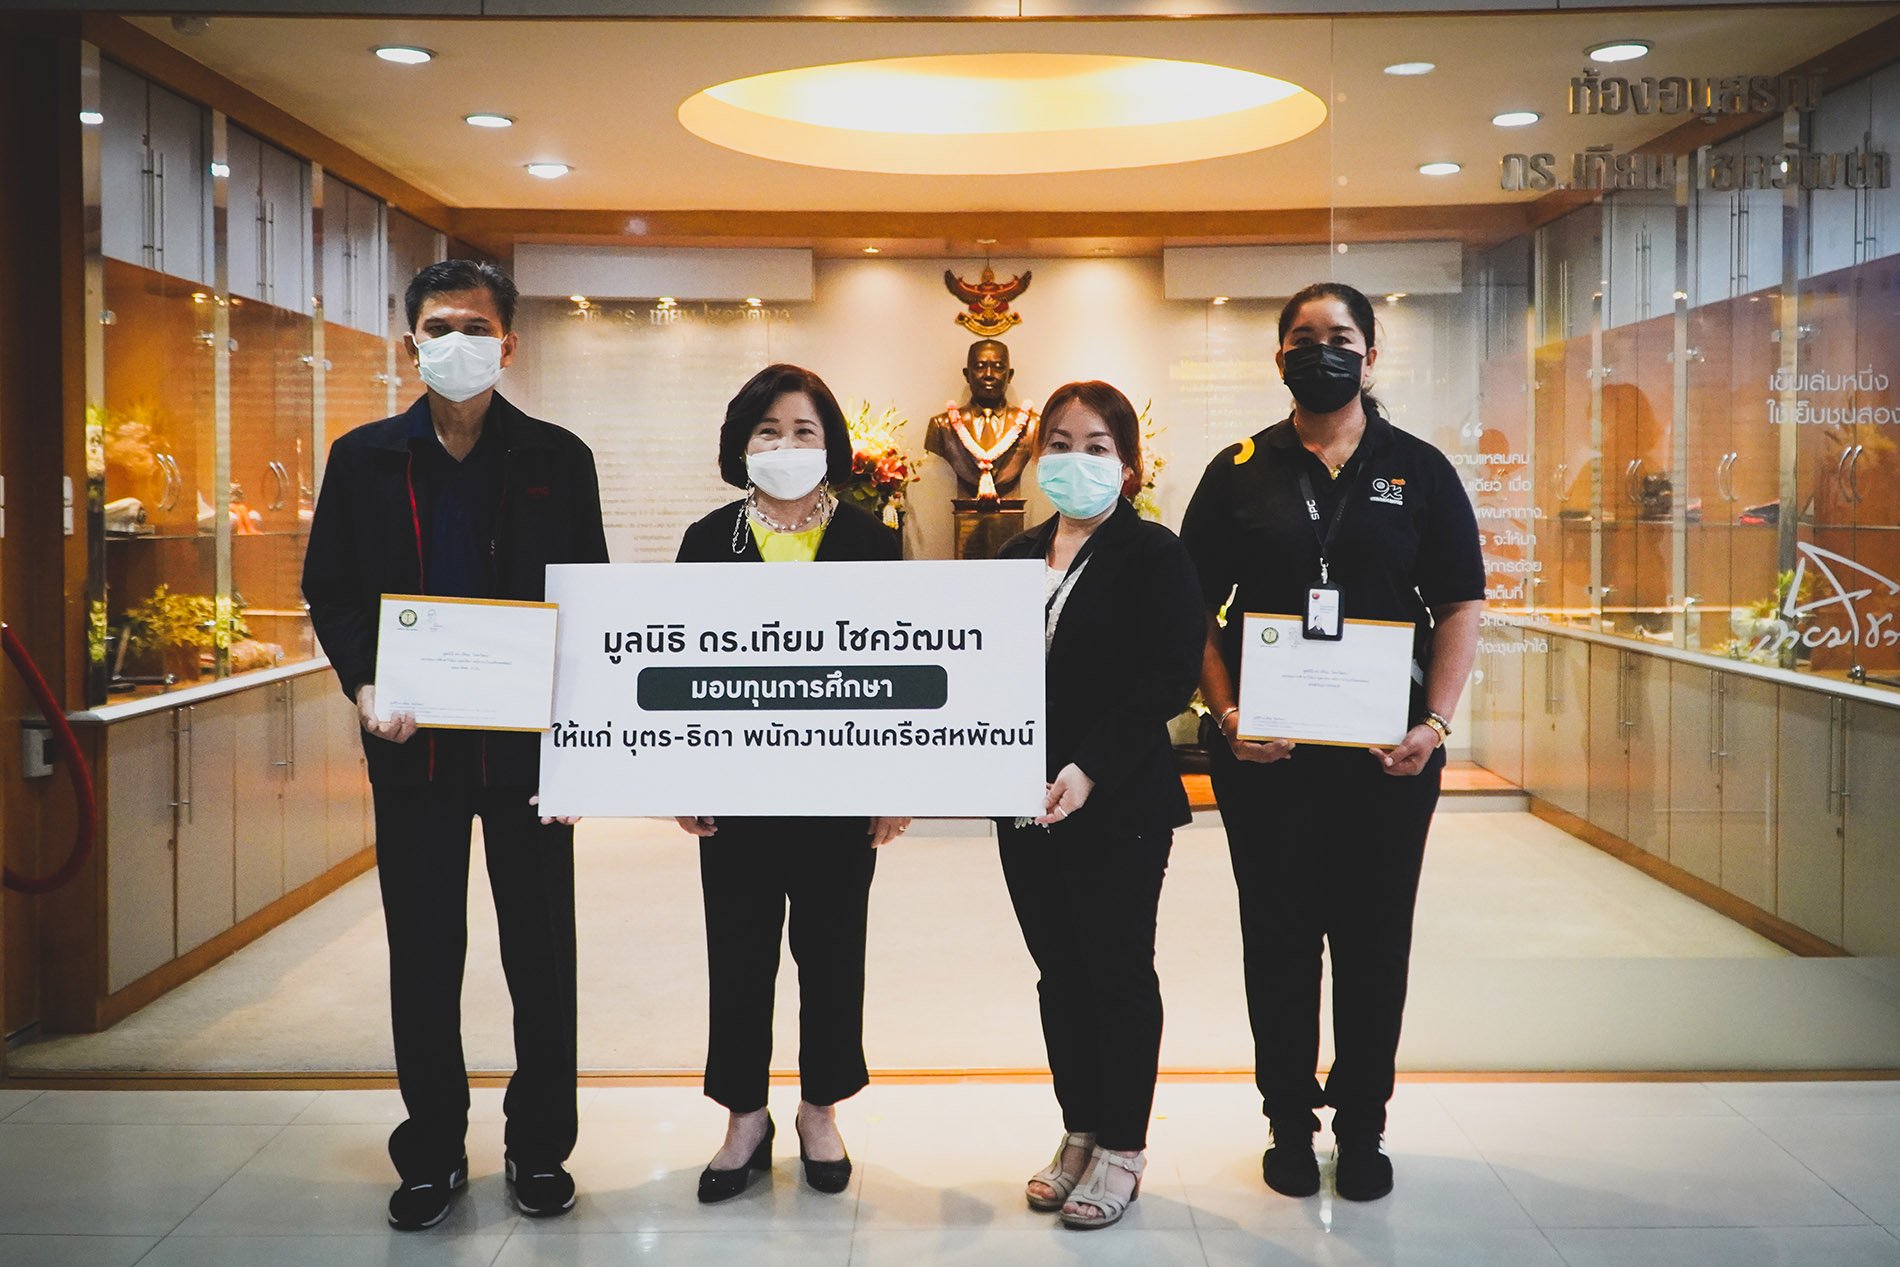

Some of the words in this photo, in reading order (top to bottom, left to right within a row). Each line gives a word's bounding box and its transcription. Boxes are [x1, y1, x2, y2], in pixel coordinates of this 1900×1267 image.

[1306, 499, 1320, 520] SPC
[603, 624, 687, 665] มูลนิธิ
[699, 622, 824, 653] ดร.เทียม
[836, 620, 983, 652] โชควัฒนา
[691, 670, 893, 707] มอบทุนการศึกษา
[552, 720, 612, 748] ให้แก่
[622, 723, 733, 756] บุตร-ธิดา
[743, 720, 1035, 748] พนักงานในเครือสหพัฒน์
